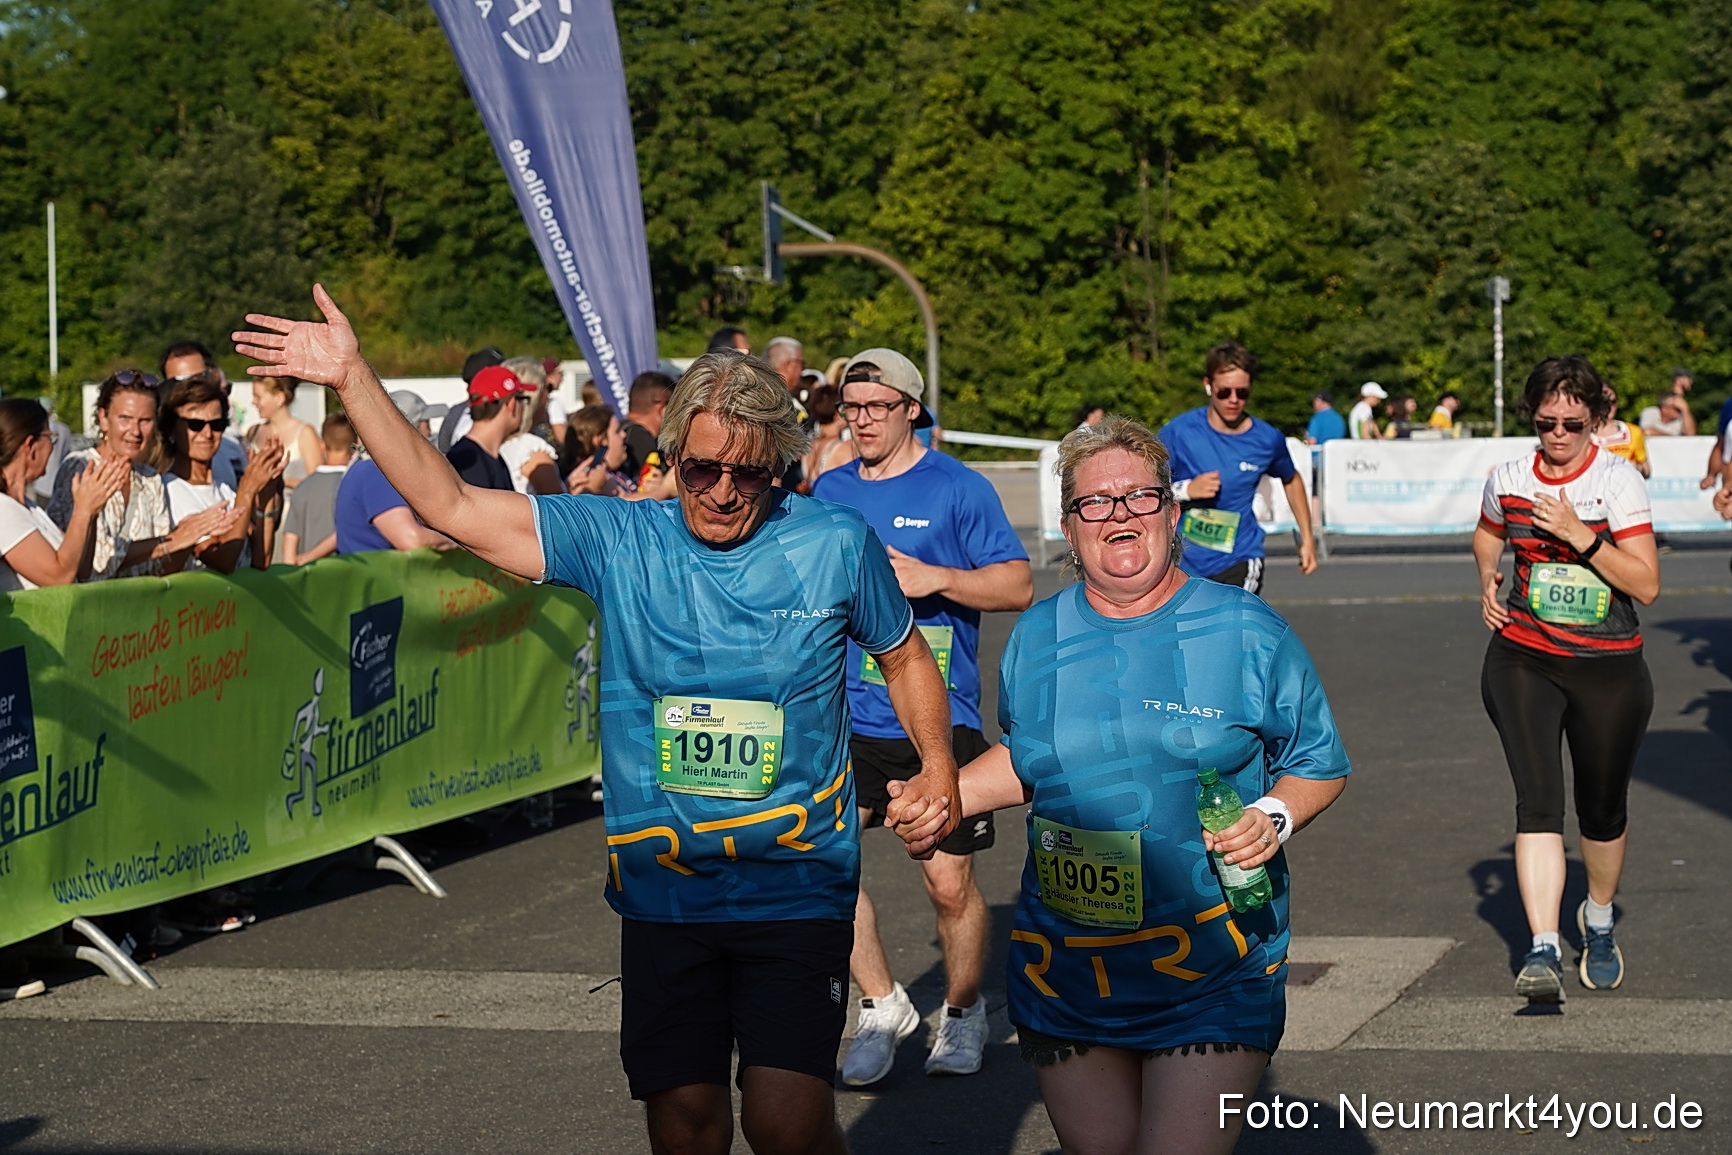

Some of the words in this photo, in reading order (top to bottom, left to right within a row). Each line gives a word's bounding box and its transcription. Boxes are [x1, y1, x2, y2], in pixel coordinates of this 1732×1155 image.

[905, 517, 930, 529] Berger
[1195, 520, 1222, 536] 467
[1549, 584, 1588, 606] 681
[770, 609, 788, 619] TR
[791, 608, 836, 619] PLAST
[92, 606, 172, 678] Gesunde
[177, 600, 237, 645] Firmen
[128, 664, 183, 723] laufen
[186, 631, 249, 703] länger!
[327, 667, 440, 781] firmenlauf
[684, 715, 726, 725] Firmenlauf
[1142, 699, 1162, 711] TR
[1166, 702, 1225, 719] PLAST
[662, 740, 671, 772] RUN
[674, 730, 759, 766] 1910
[761, 741, 776, 785] 2022
[327, 764, 381, 806] neumarkt
[682, 764, 708, 778] Hierl
[711, 767, 748, 780] Martin
[1055, 841, 1084, 853] Firmenlauf
[1040, 856, 1052, 900] WALK
[1049, 855, 1121, 897] 1905
[1050, 886, 1079, 905] Häusler
[1081, 896, 1125, 911] Theresa
[1123, 871, 1137, 915] 2022
